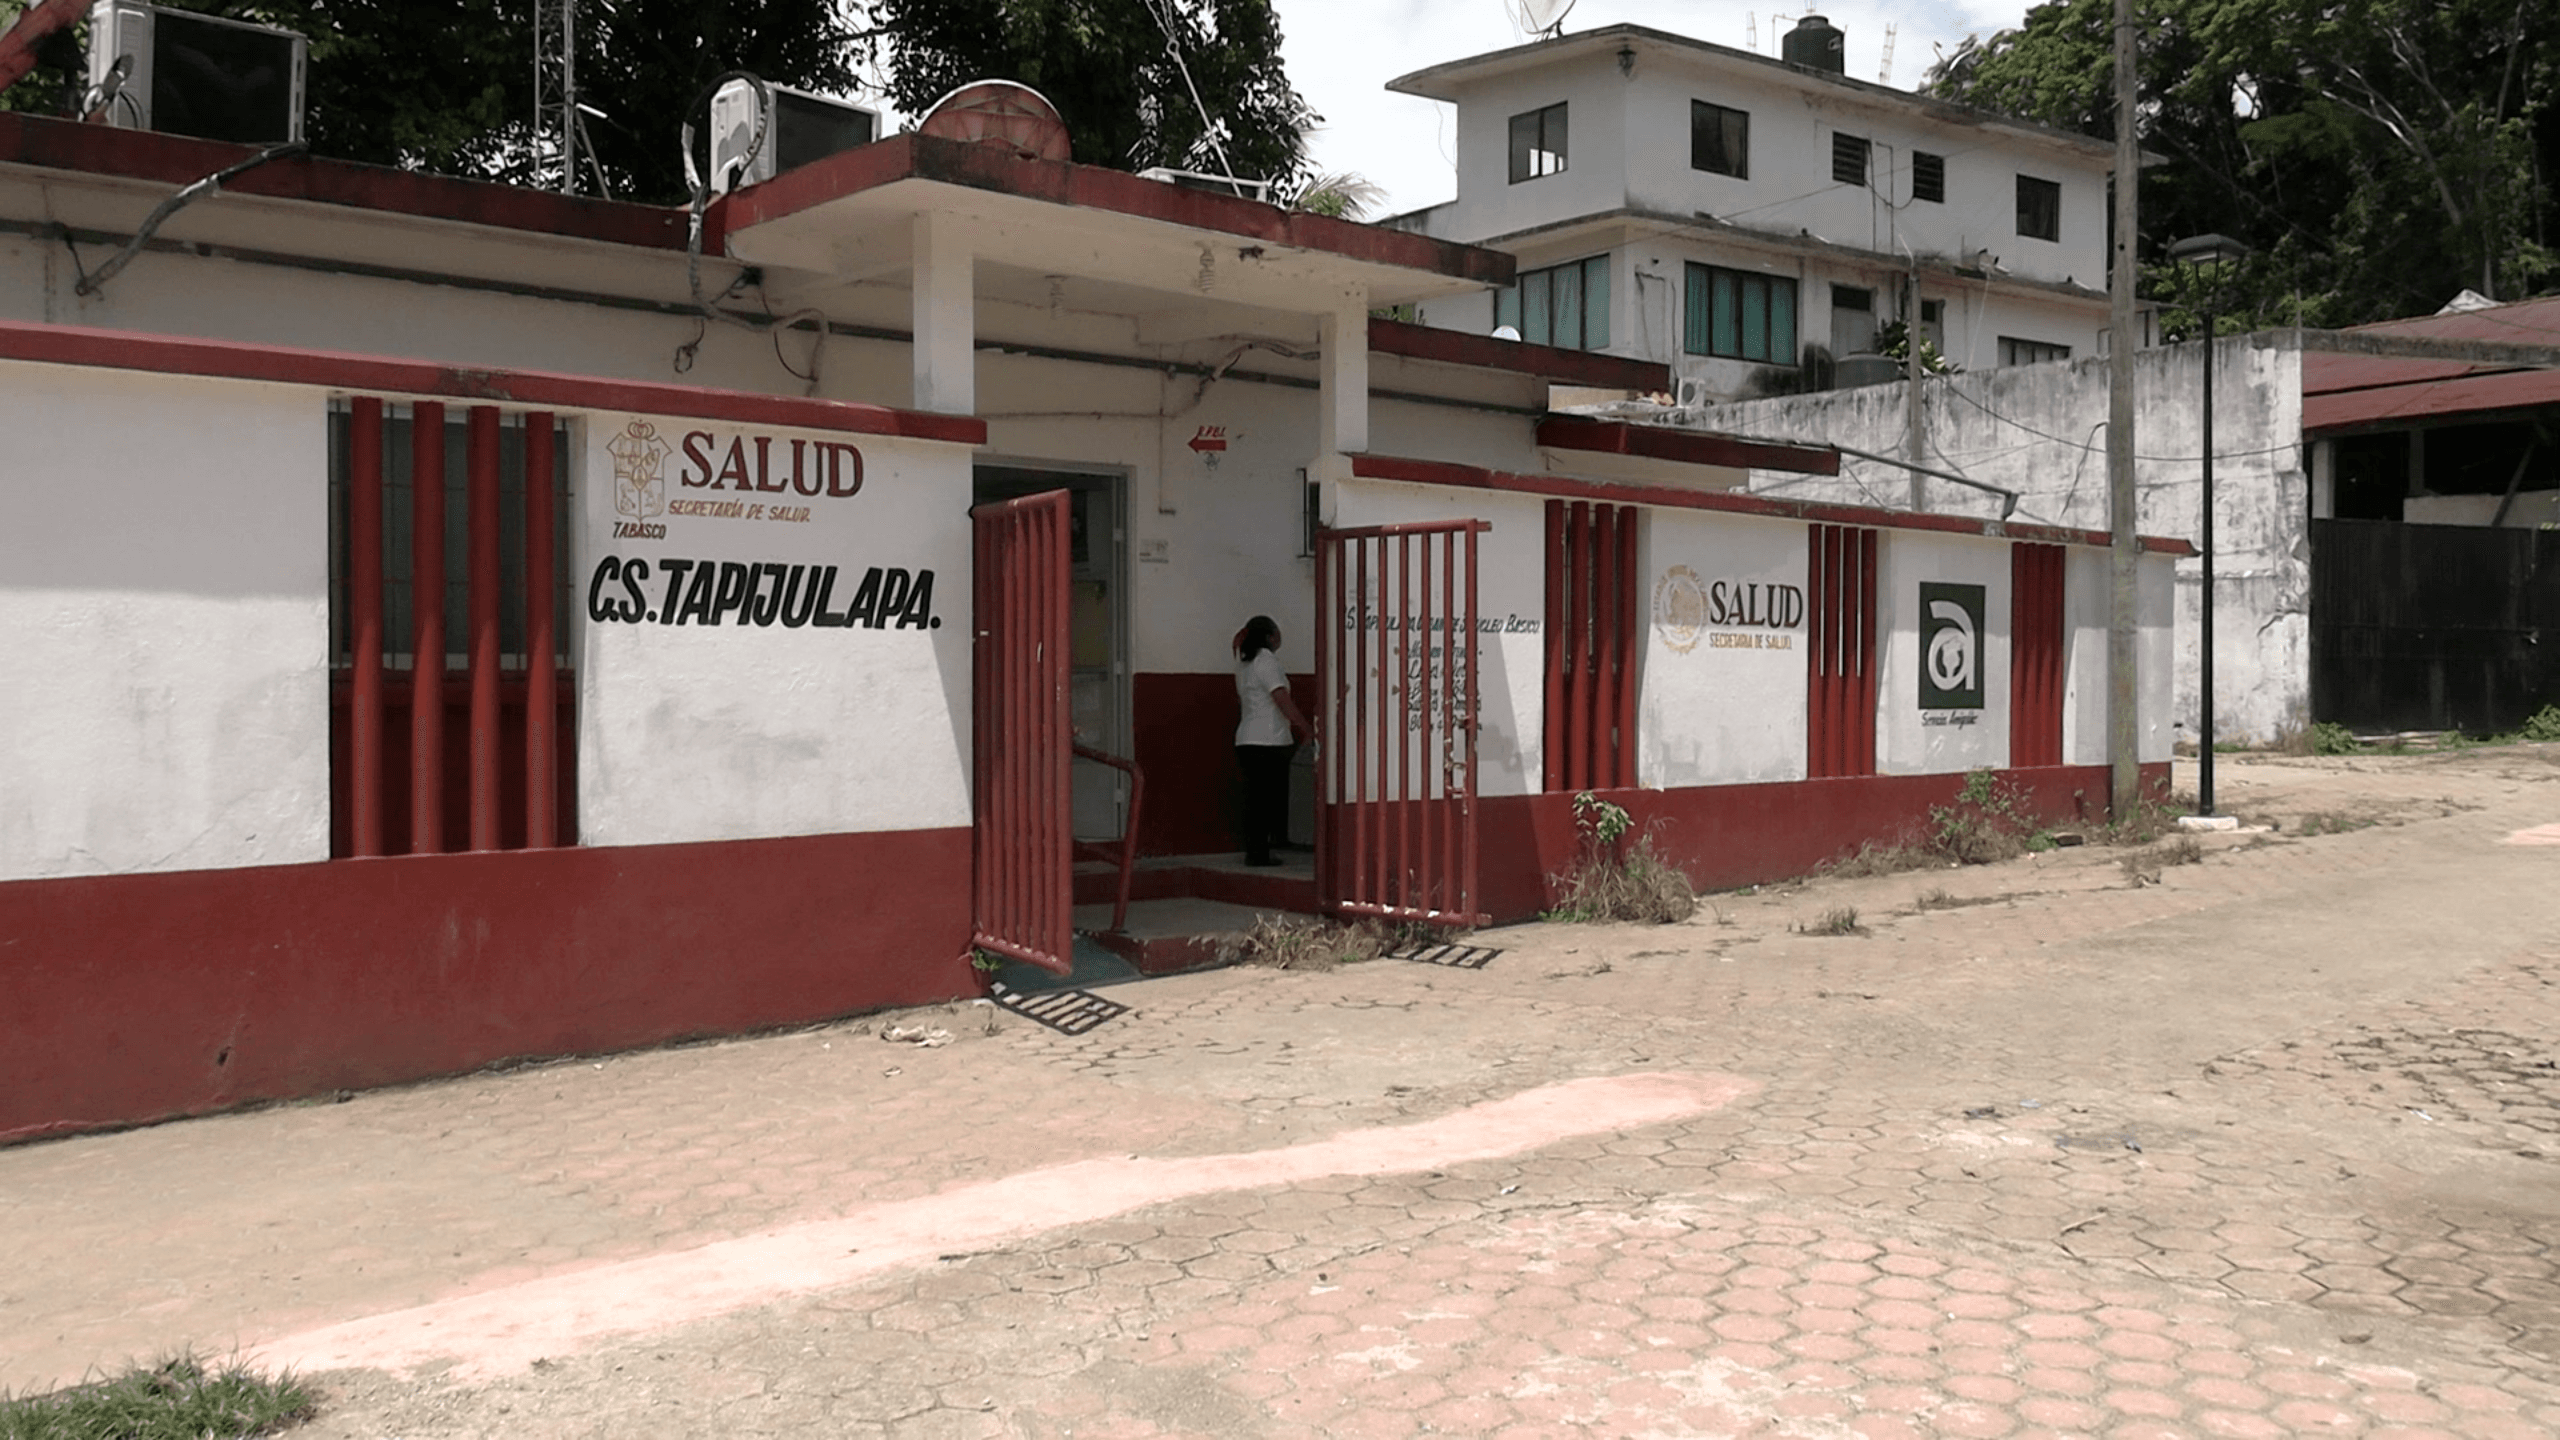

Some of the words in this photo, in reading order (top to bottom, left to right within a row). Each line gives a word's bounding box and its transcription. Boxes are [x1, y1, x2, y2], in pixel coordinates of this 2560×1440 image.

[682, 431, 864, 497] SALUD
[668, 498, 743, 518] SECRETARÍA
[746, 504, 764, 520] DE
[613, 521, 667, 539] TABASCO
[1710, 580, 1803, 629] SALUD
